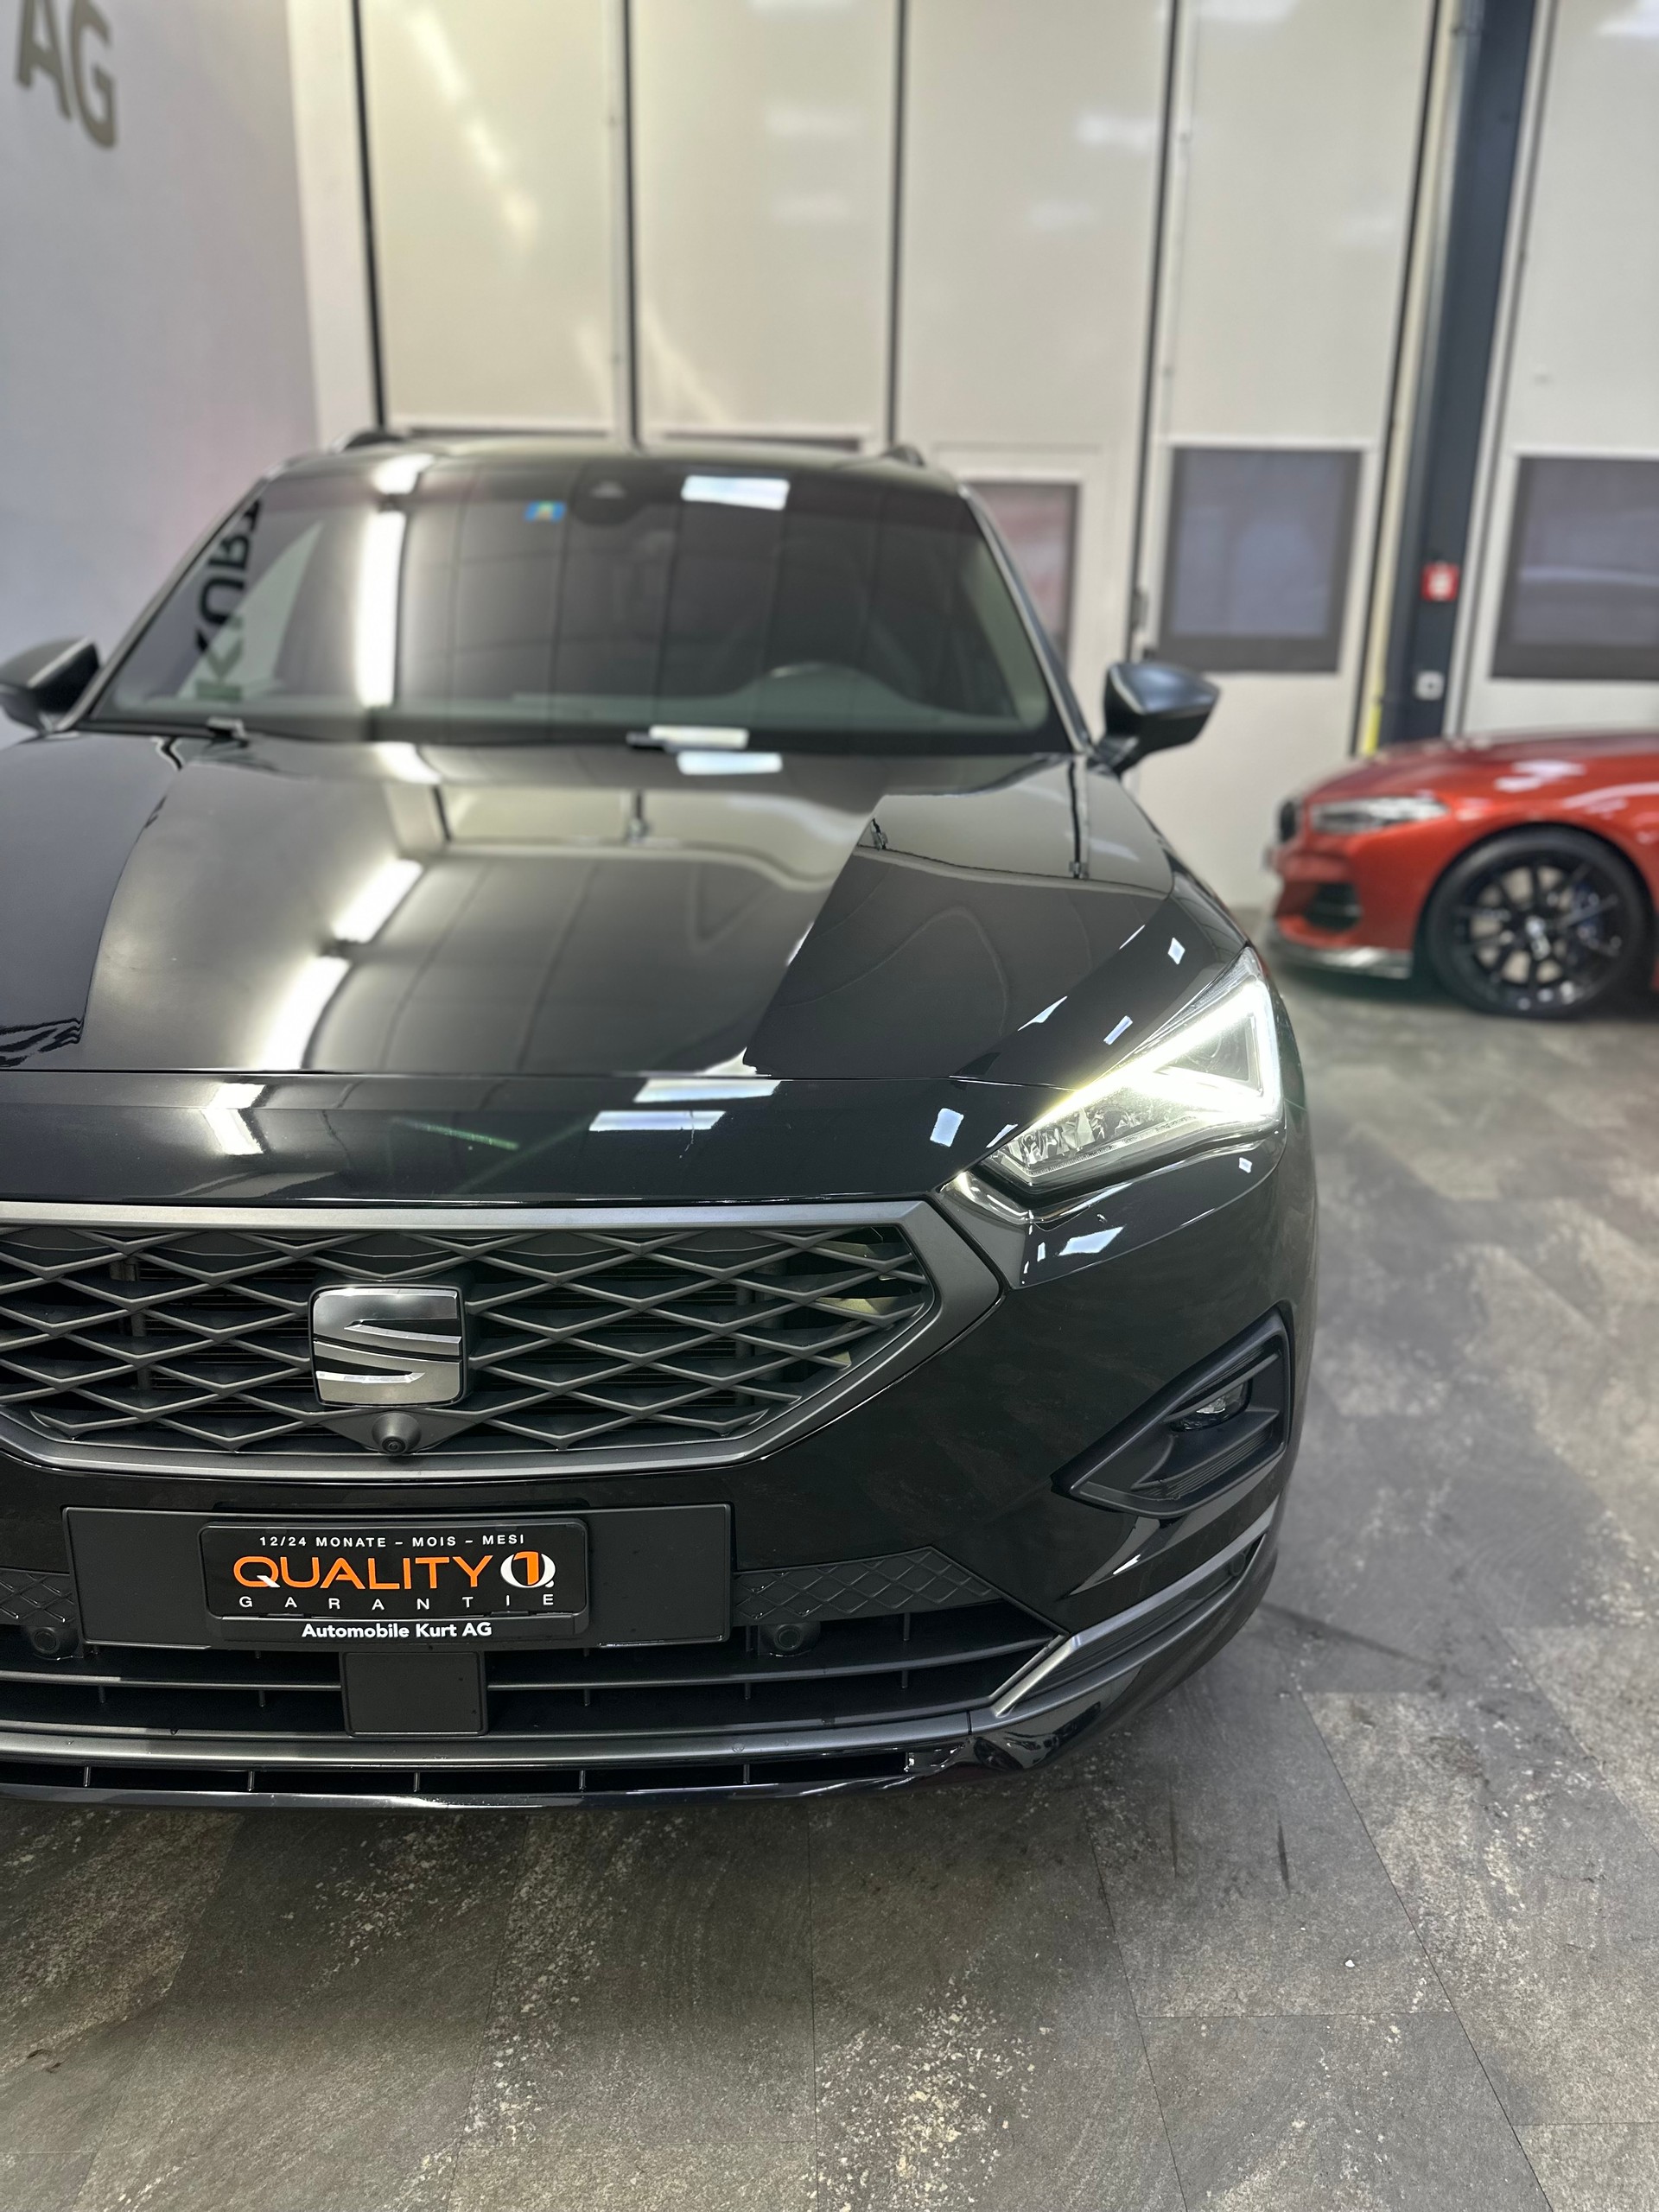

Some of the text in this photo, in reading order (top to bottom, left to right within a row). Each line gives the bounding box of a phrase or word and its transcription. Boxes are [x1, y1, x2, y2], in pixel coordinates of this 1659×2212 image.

[15, 0, 118, 149] AG
[259, 1535, 307, 1547] 12/24
[315, 1536, 387, 1548] MONATE
[411, 1535, 457, 1548] MOIS
[482, 1534, 524, 1546] MESI
[233, 1554, 493, 1590] QUALITY
[238, 1594, 554, 1611] GARANTIE
[302, 1621, 493, 1638] Automobile Kurt AG
